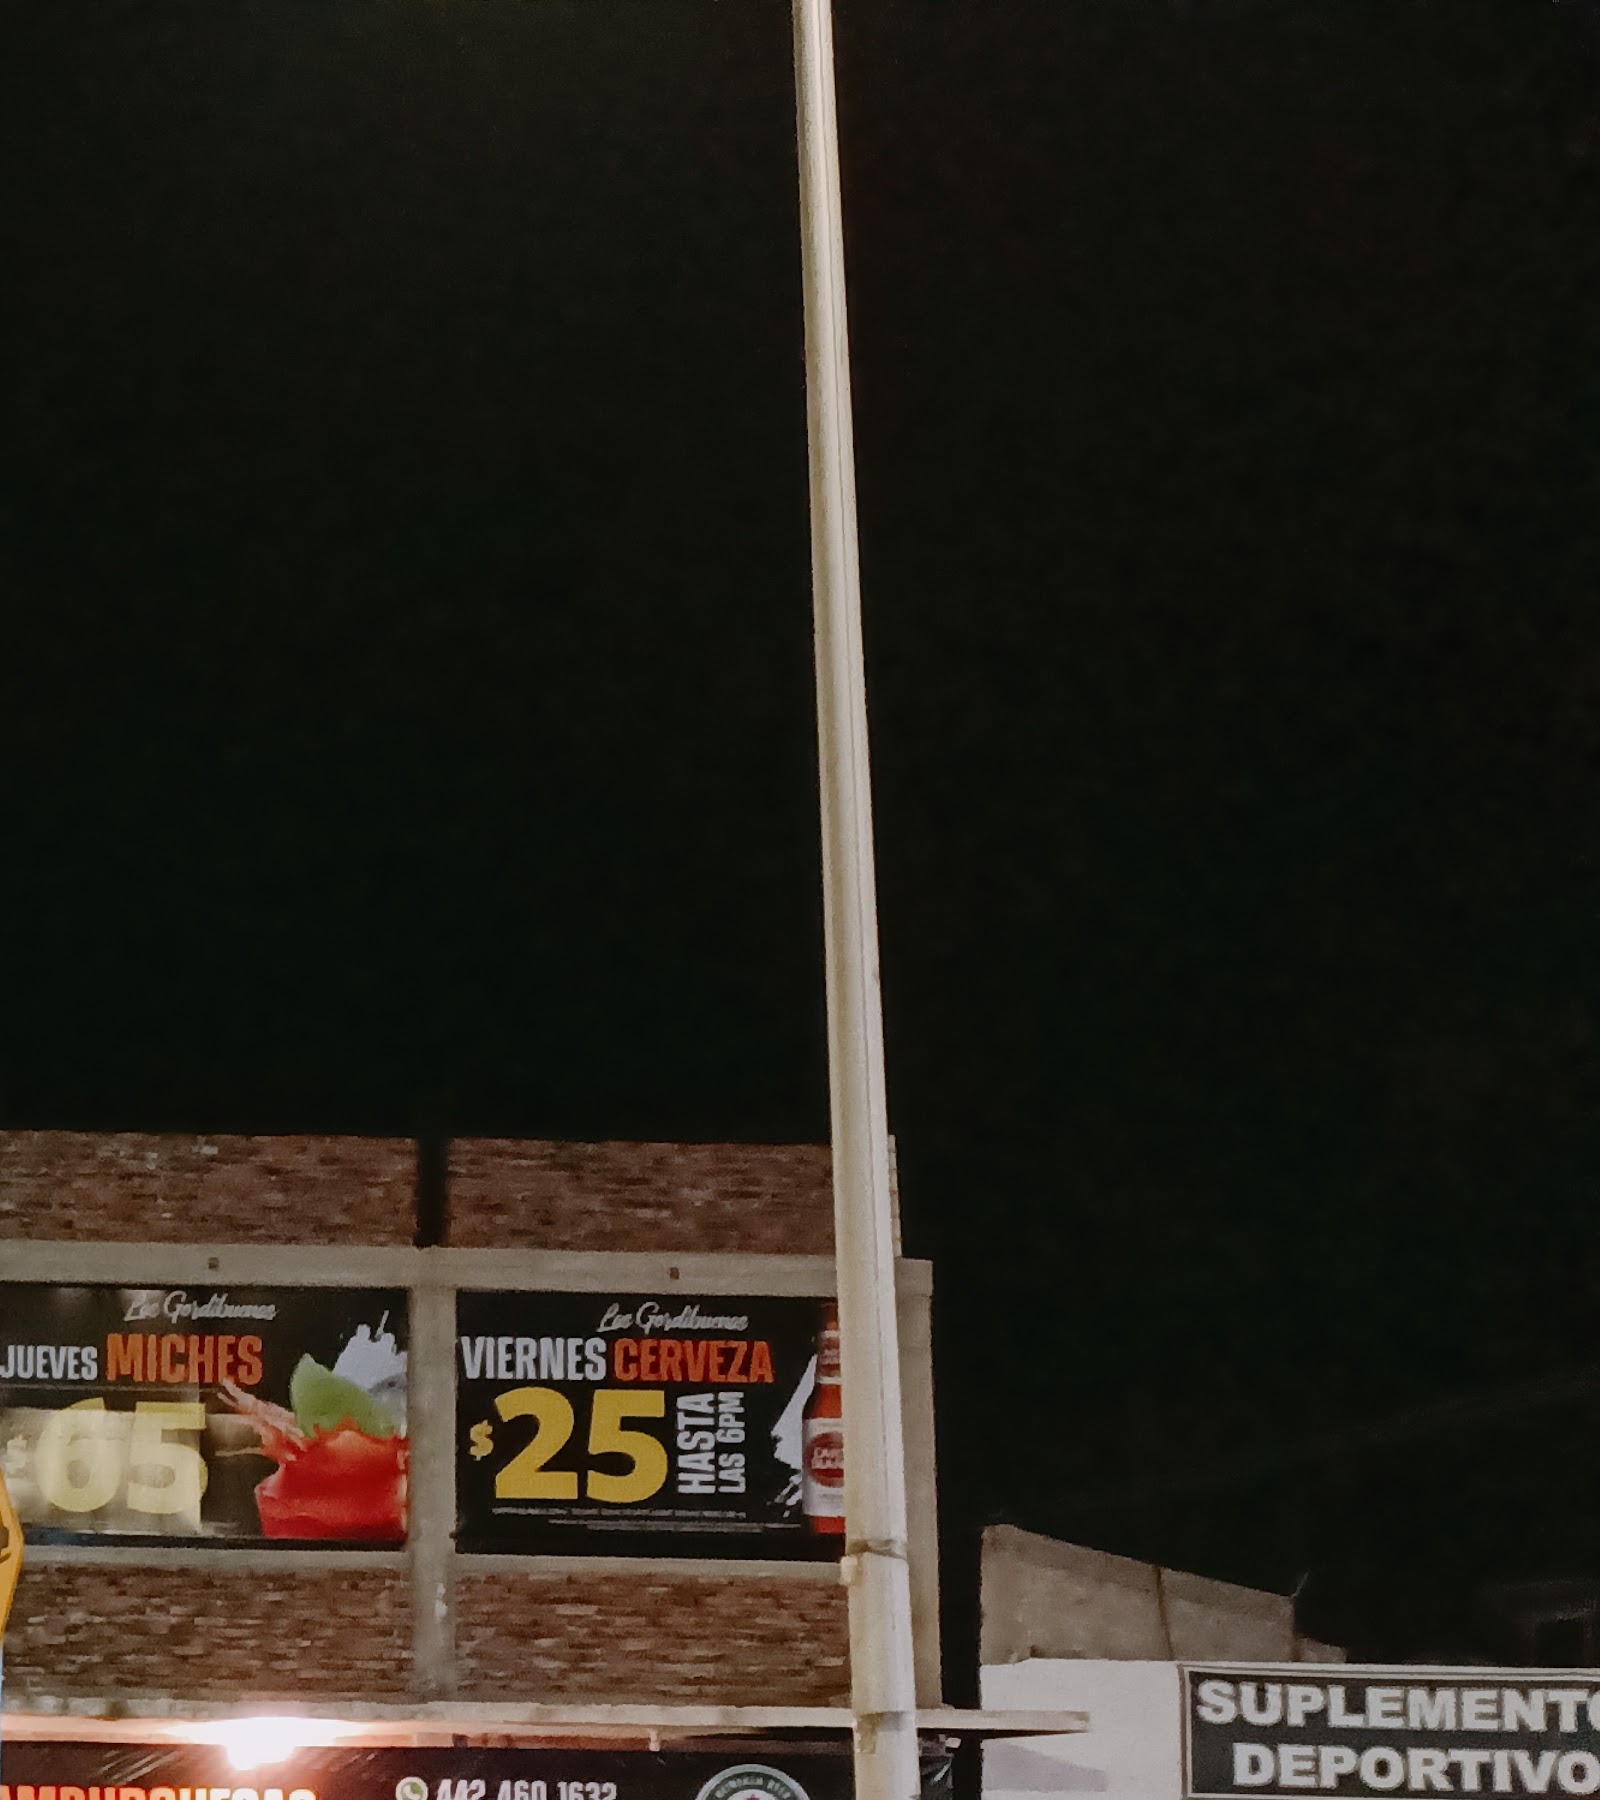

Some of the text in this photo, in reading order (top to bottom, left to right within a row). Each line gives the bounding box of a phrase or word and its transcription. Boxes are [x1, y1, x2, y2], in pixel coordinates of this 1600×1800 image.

[0, 1333, 263, 1386] JUEVES MICHES
[460, 1336, 775, 1384] VIERNES CERVEZA
[676, 1392, 716, 1494] HASTA
[716, 1391, 746, 1494] LAS 6PM
[1197, 1678, 1600, 1732] SUPLEMENT
[1232, 1742, 1600, 1795] DEPORTIVO
